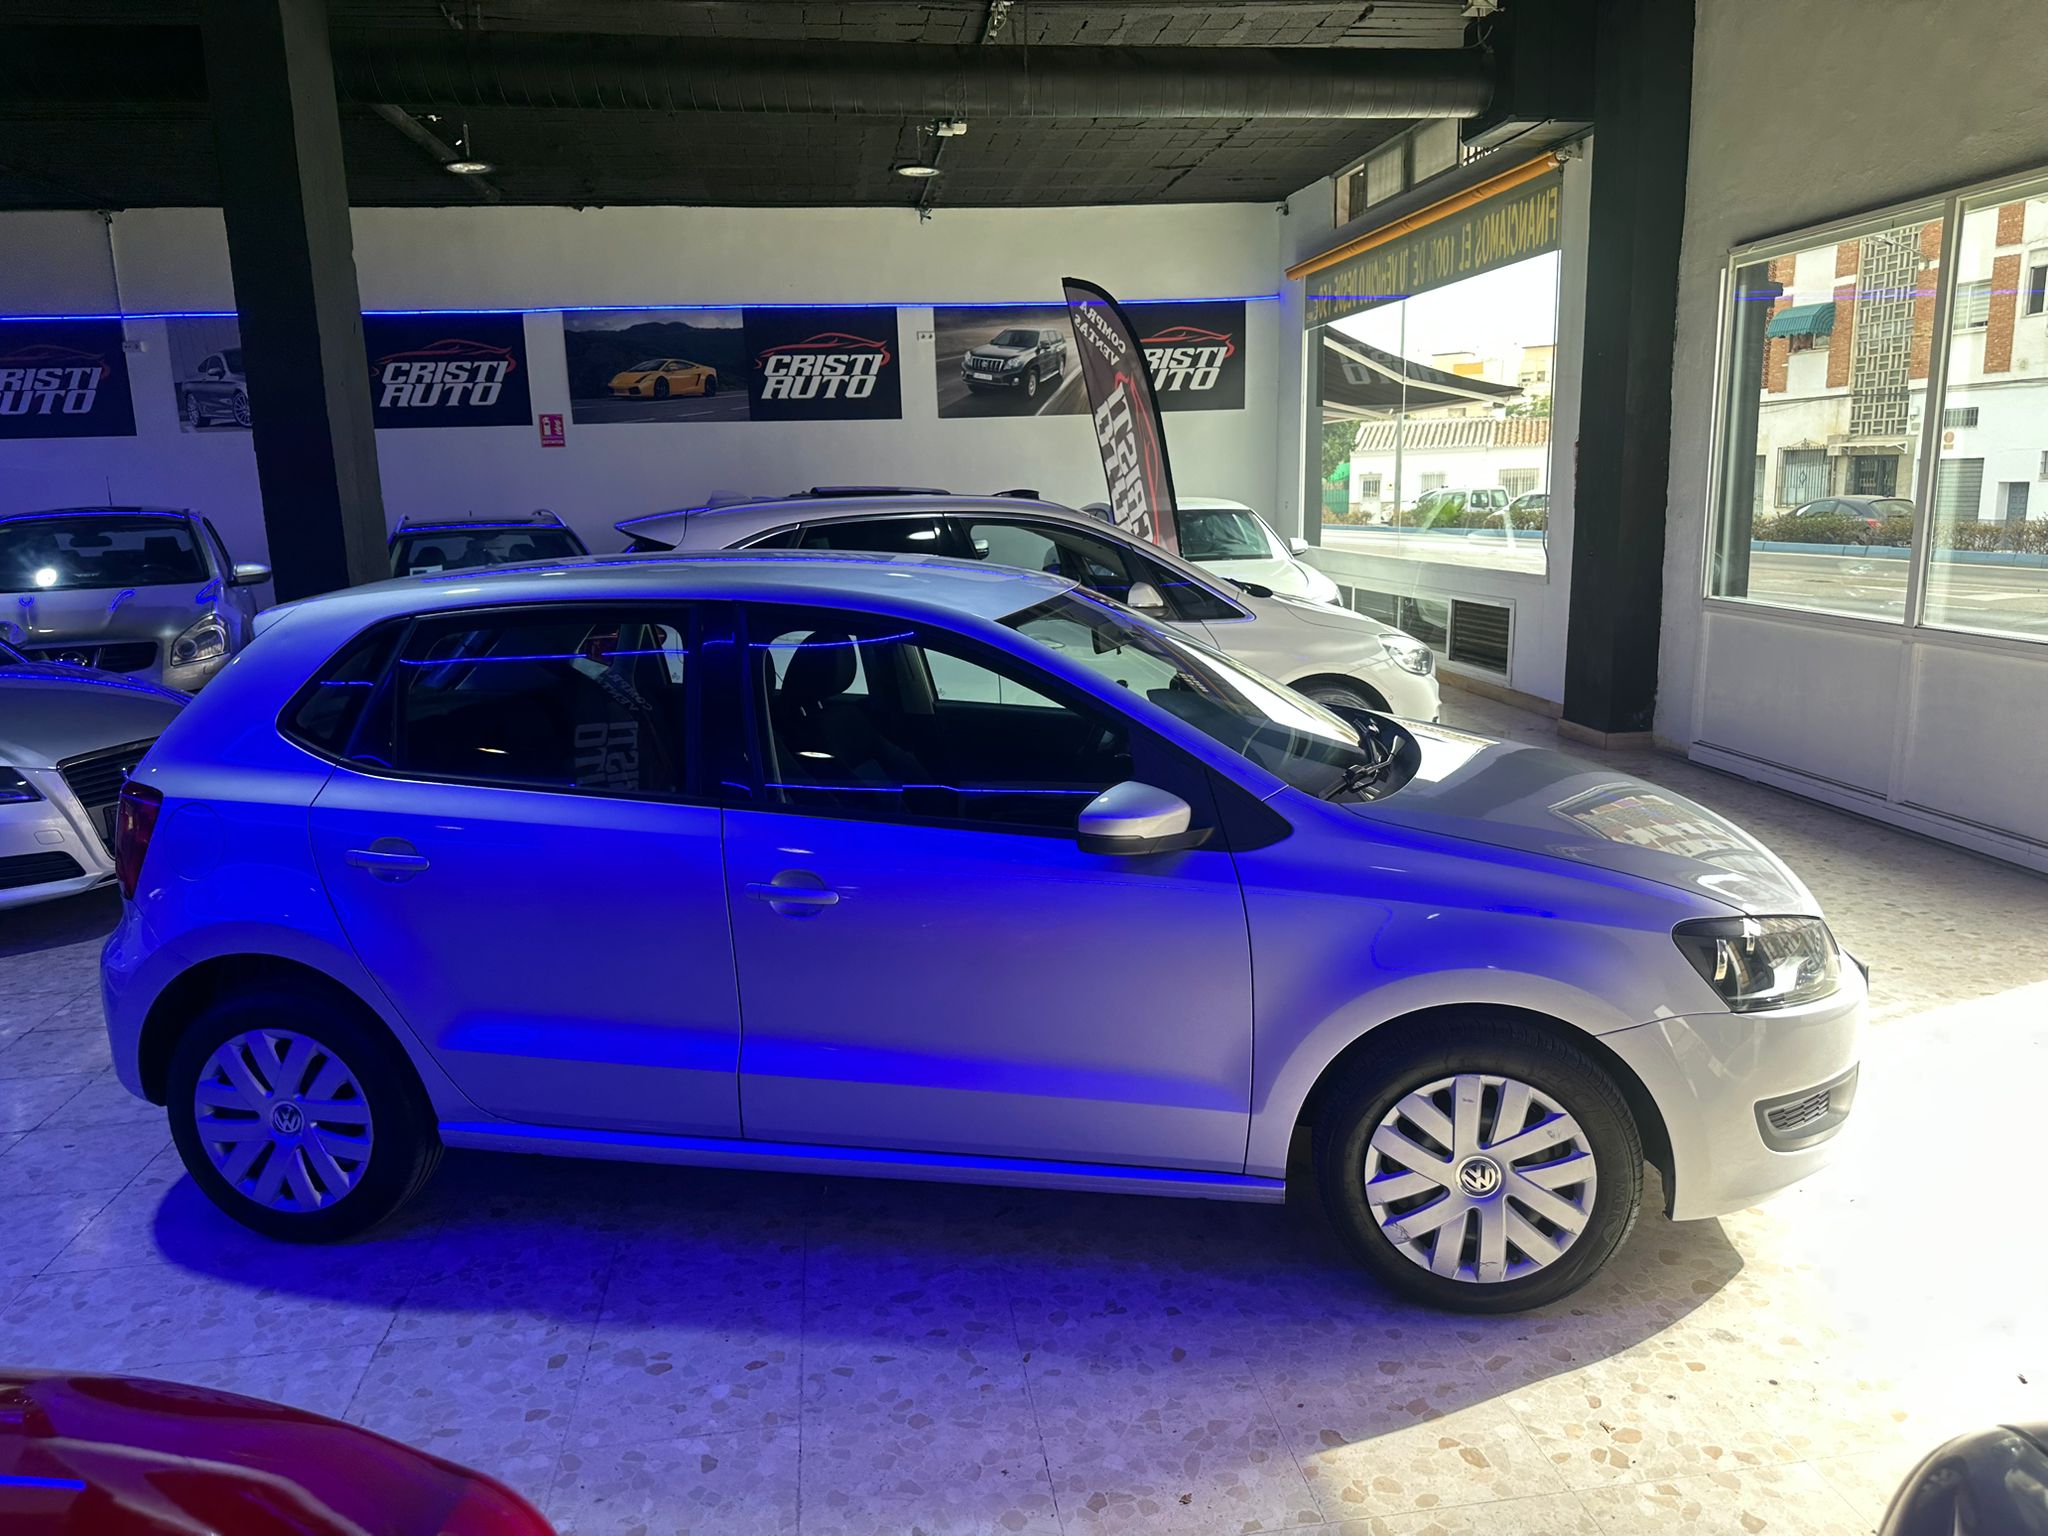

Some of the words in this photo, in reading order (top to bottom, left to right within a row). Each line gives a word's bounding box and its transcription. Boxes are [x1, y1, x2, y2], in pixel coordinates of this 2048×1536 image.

[764, 353, 884, 377] CRISTI
[1143, 346, 1228, 369] RISTI
[0, 367, 103, 391] RISTI
[382, 360, 509, 385] CRISTI
[379, 382, 503, 407] AUTO
[761, 374, 878, 400] AUTO
[0, 390, 97, 415] UTO
[1460, 1162, 1498, 1193] VW
